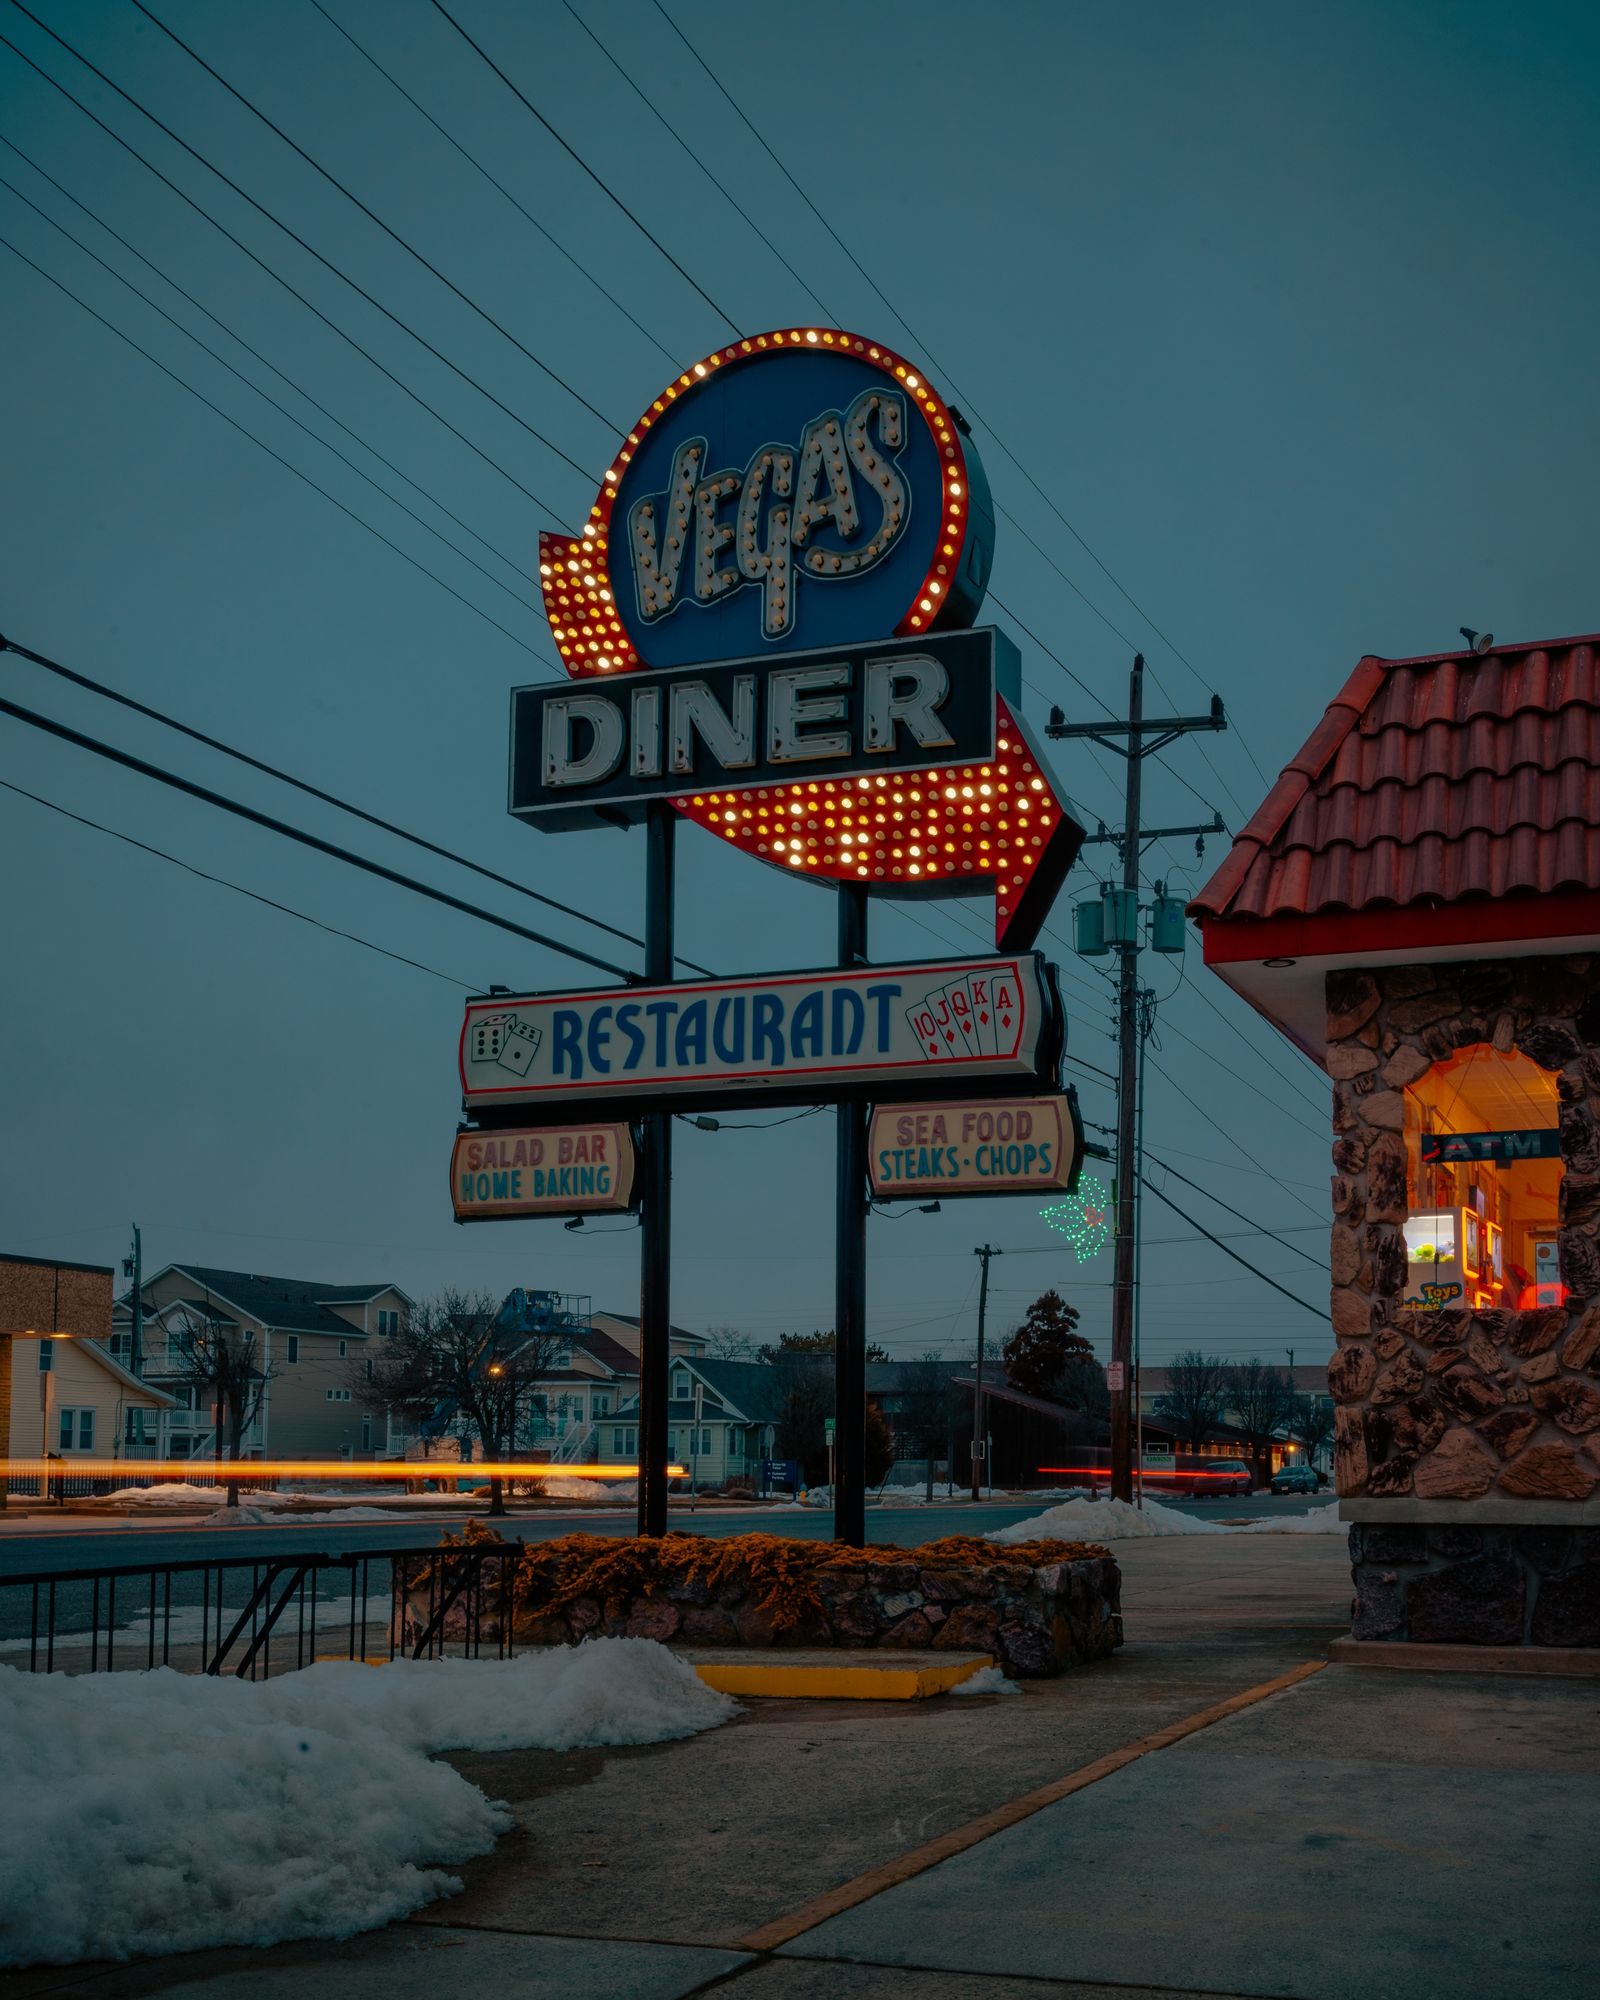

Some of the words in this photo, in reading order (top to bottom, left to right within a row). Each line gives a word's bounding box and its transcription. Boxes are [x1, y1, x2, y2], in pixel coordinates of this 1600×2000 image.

[630, 388, 909, 639] VEGAS
[541, 653, 956, 787] DINER
[972, 980, 988, 1005] K
[996, 986, 1014, 1009] A
[552, 984, 902, 1079] RESTAURANT
[896, 1114, 948, 1146] SEA
[961, 1110, 1033, 1143] FOOD
[1443, 1133, 1541, 1159] ATM
[467, 1137, 546, 1172] SALAD
[557, 1133, 606, 1165] BAR
[461, 1169, 522, 1203] HOME
[533, 1164, 611, 1197] BAKING
[1423, 1285, 1459, 1300] Toys
